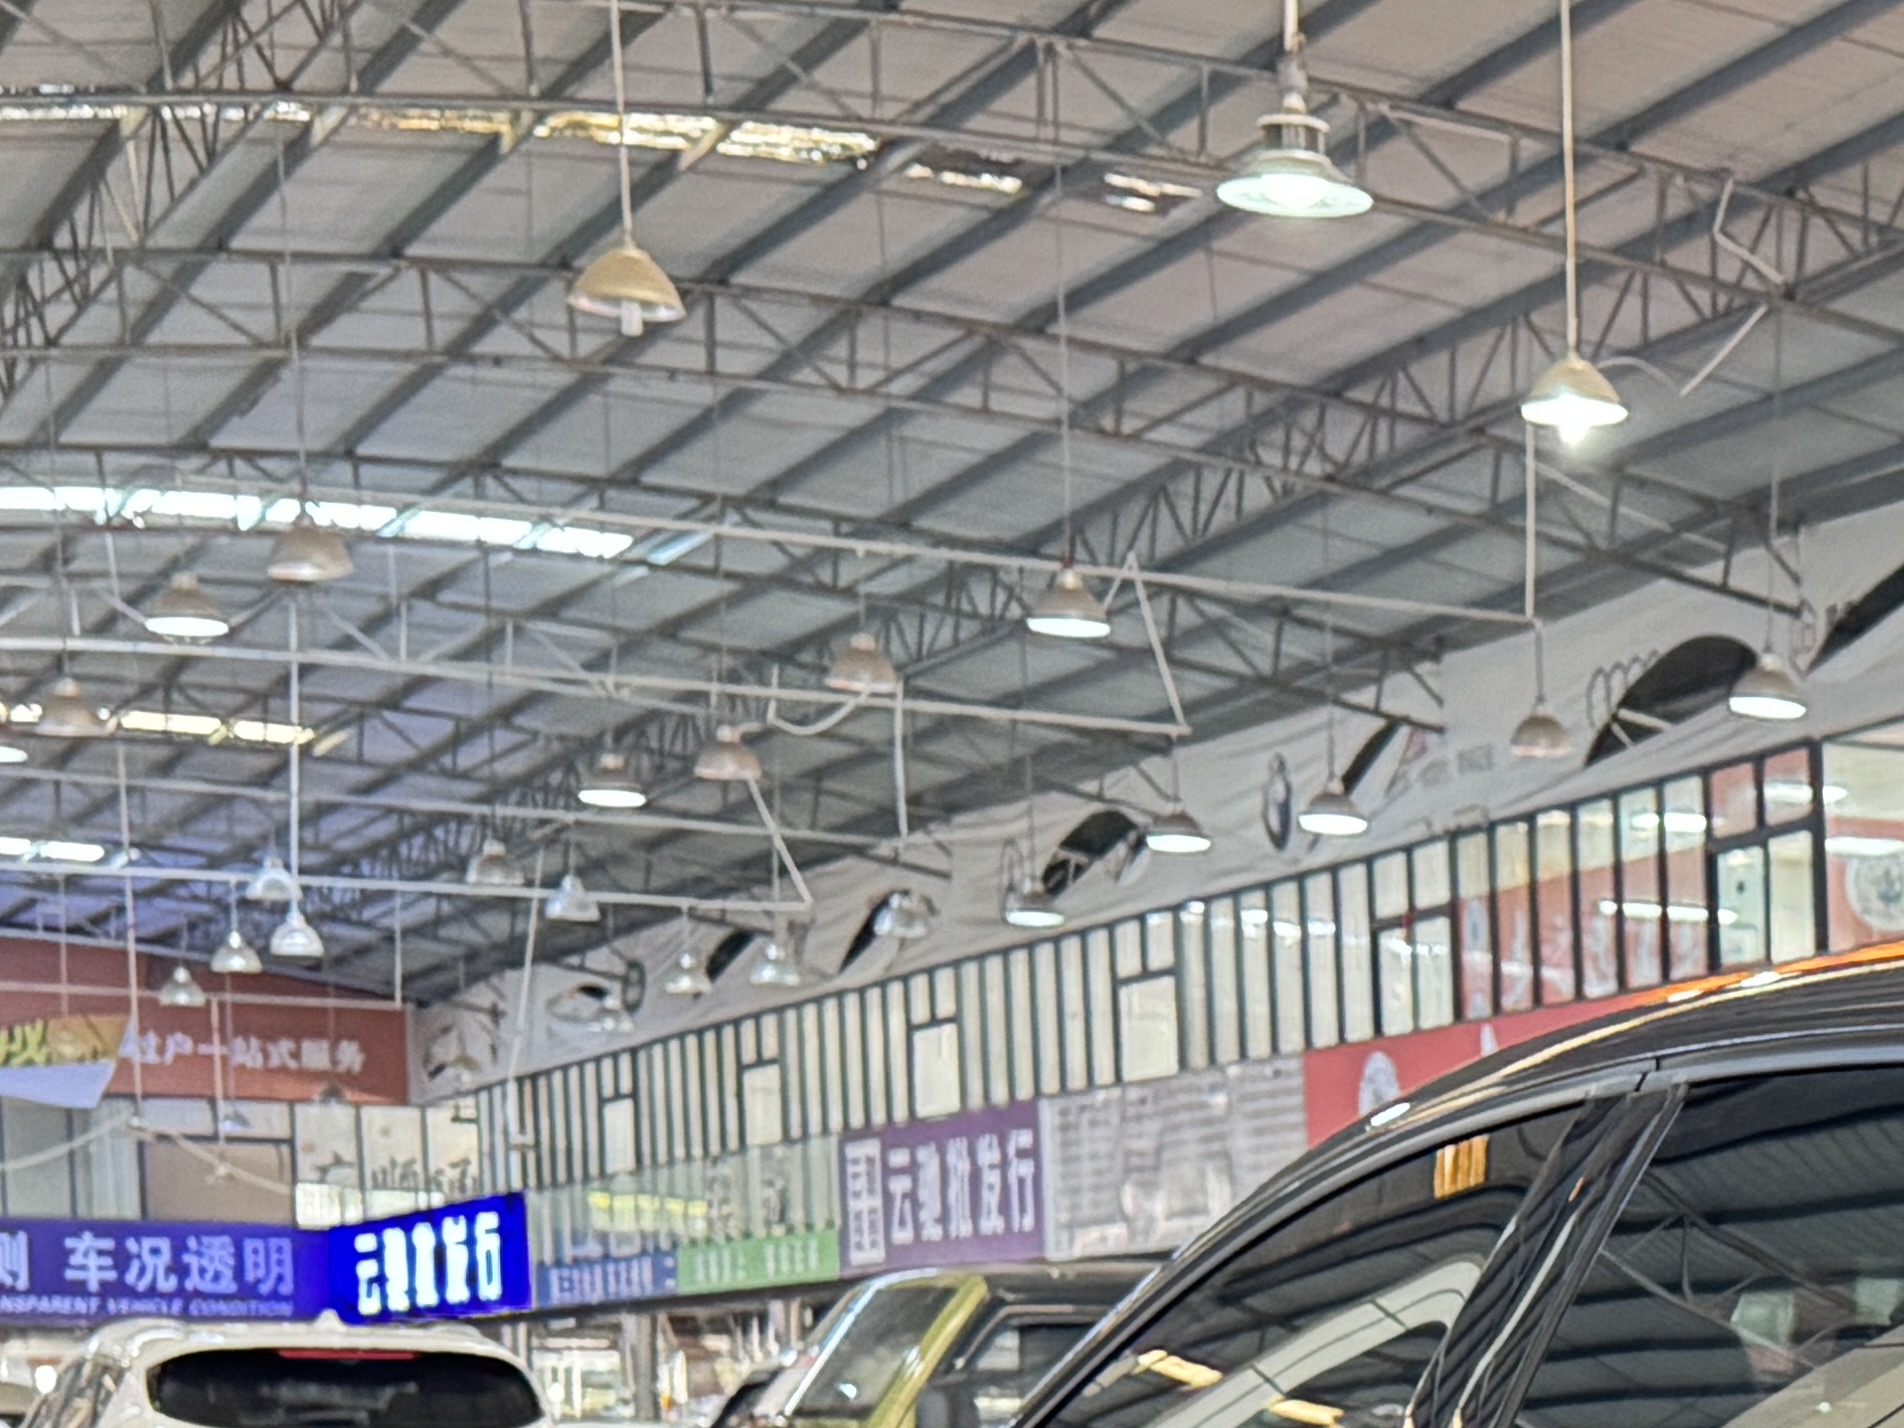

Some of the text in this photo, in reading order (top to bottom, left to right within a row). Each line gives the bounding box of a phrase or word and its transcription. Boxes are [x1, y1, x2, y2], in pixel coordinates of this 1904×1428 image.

[63, 1229, 294, 1296] 车况透明
[189, 1296, 293, 1318] CONDITION
